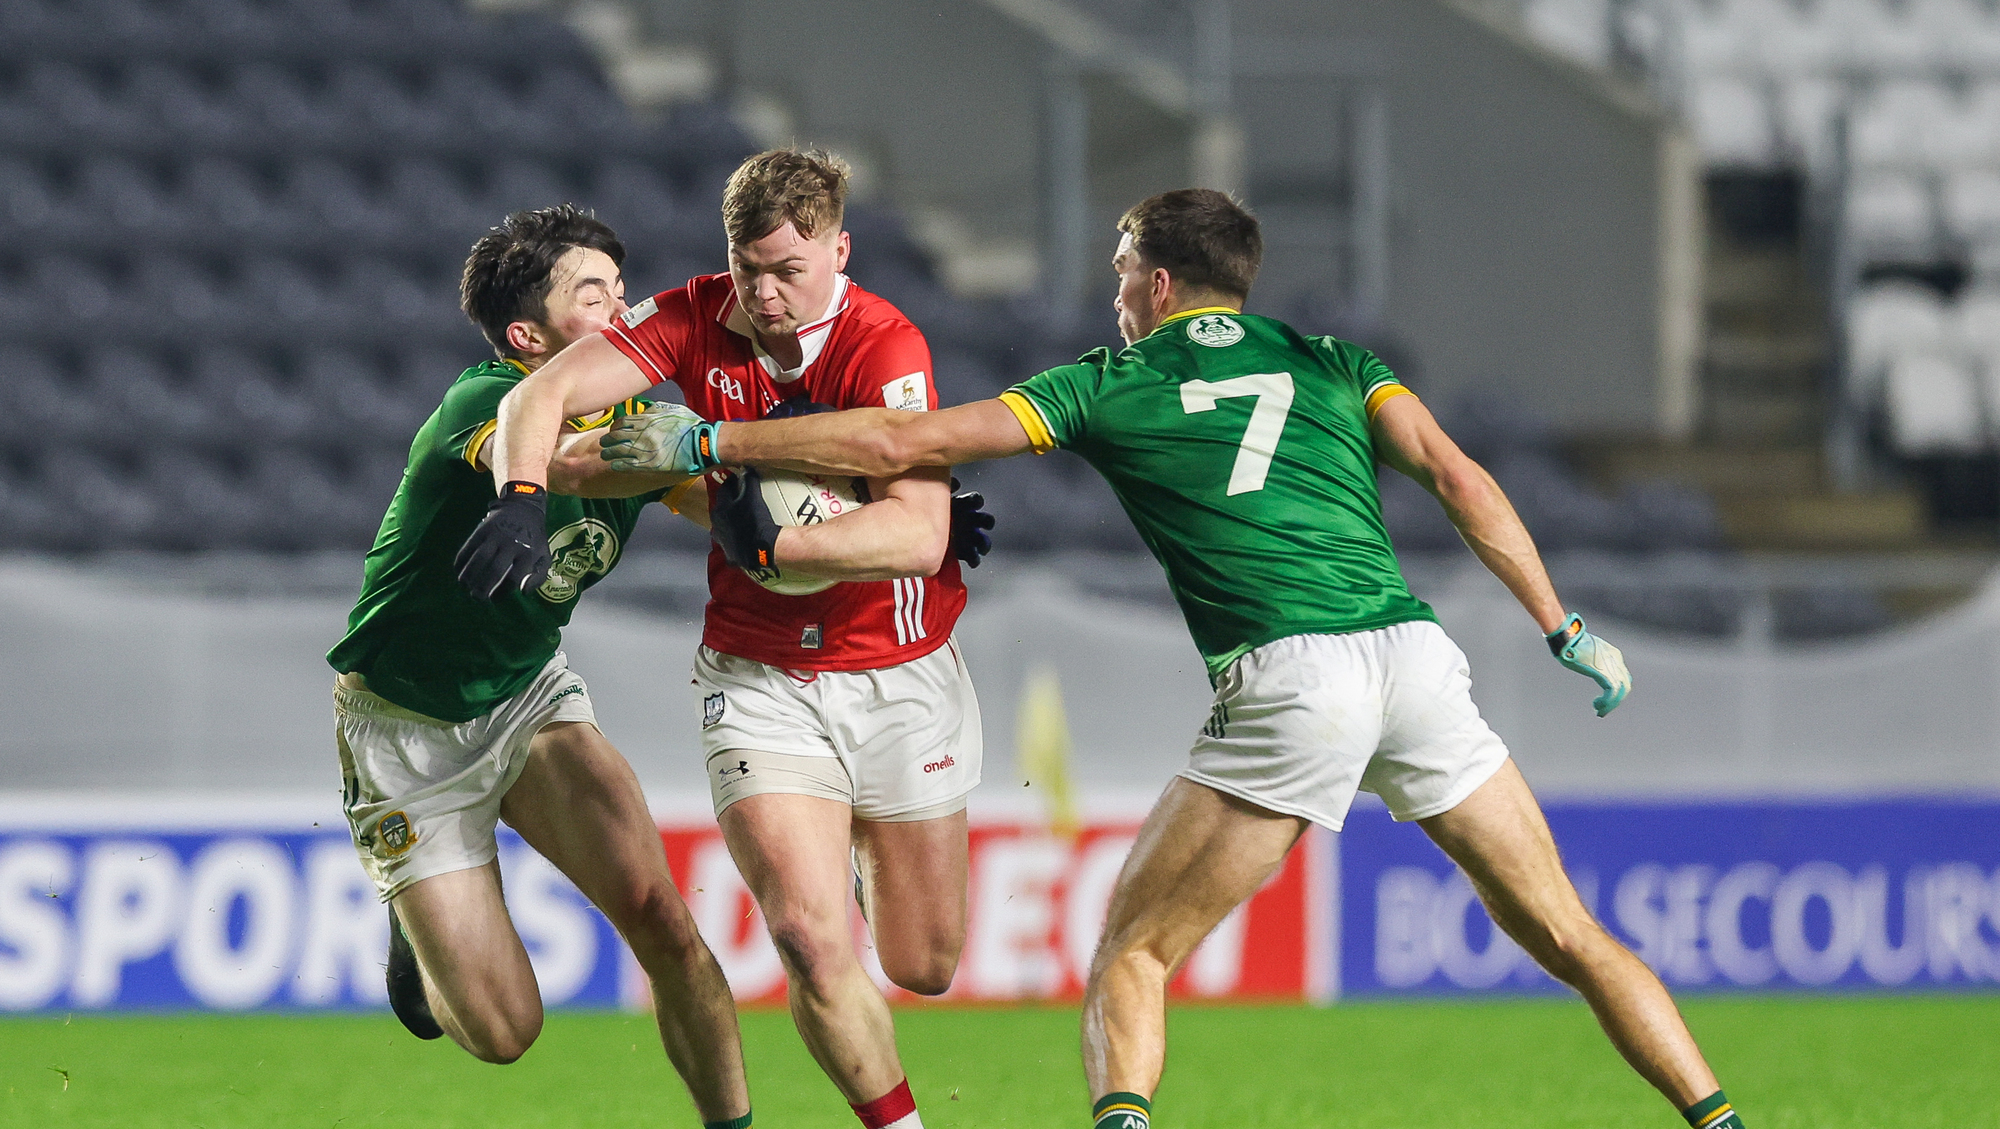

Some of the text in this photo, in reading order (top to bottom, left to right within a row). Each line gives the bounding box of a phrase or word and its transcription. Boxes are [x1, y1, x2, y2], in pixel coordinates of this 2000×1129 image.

[1179, 371, 1296, 497] 7
[0, 837, 600, 1009] SPORS
[1374, 862, 1599, 989] BO
